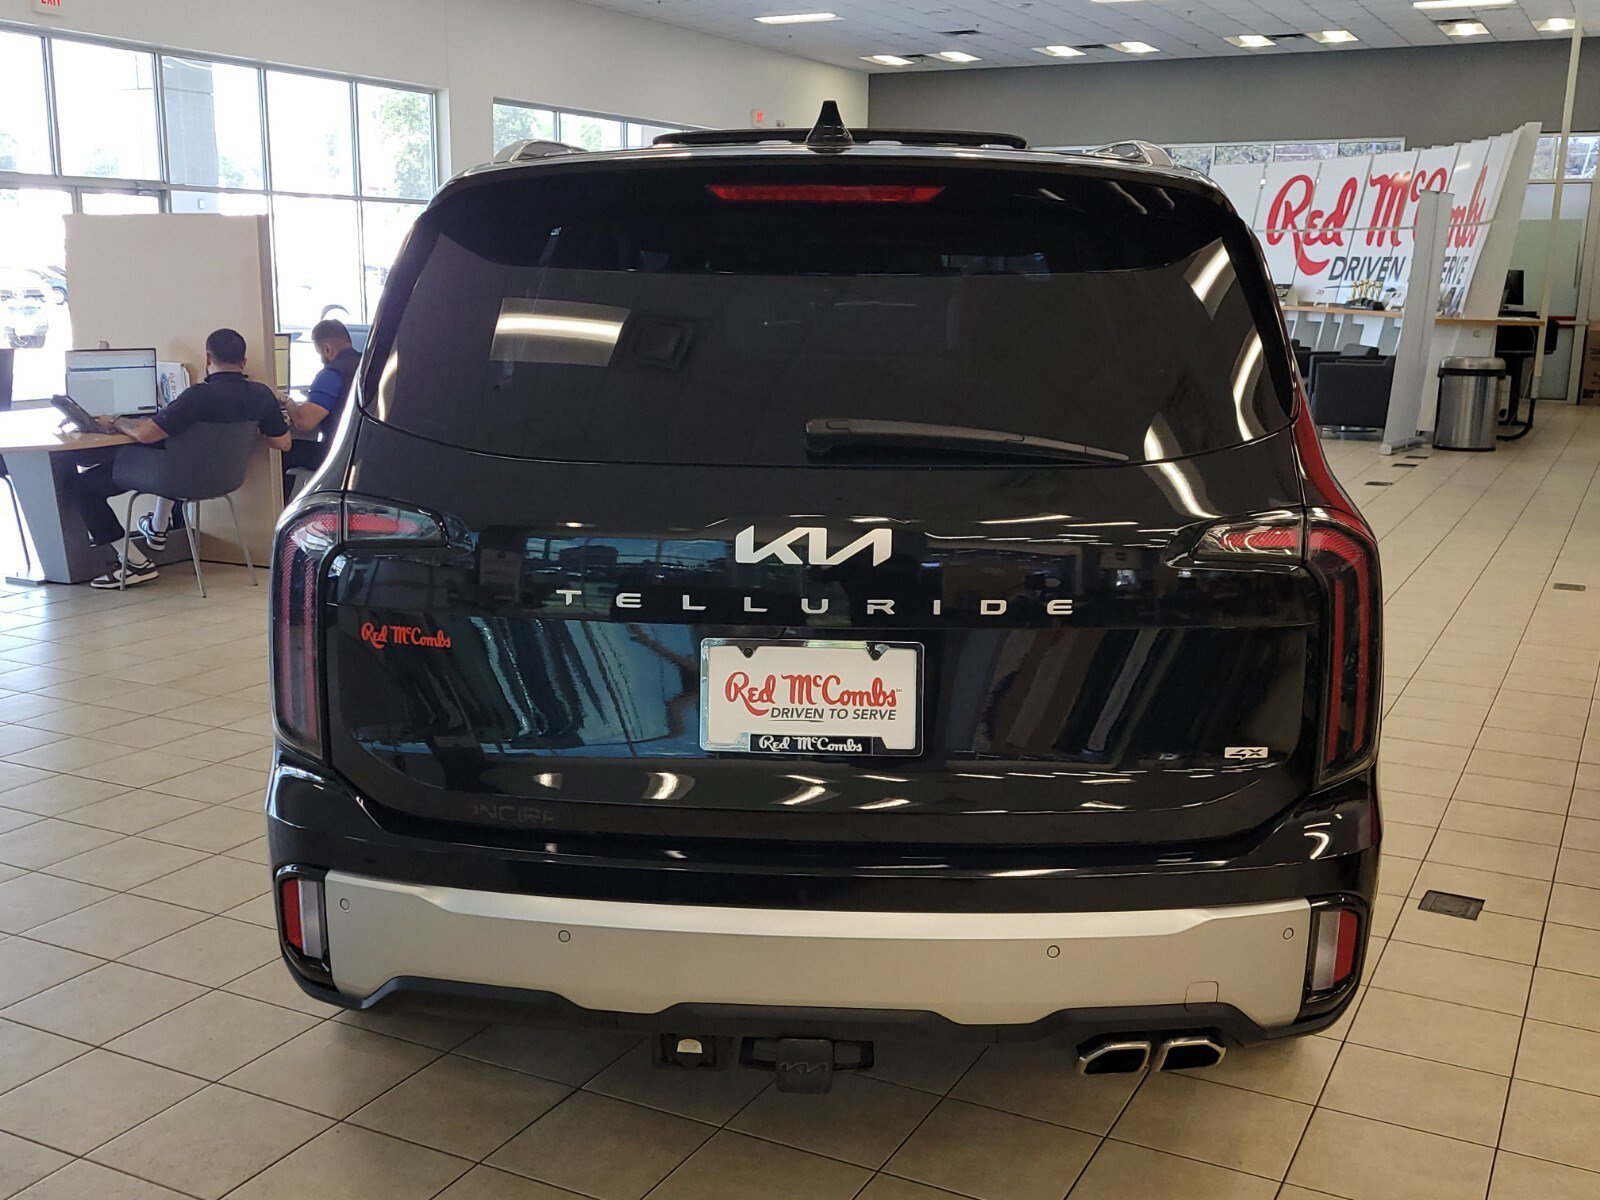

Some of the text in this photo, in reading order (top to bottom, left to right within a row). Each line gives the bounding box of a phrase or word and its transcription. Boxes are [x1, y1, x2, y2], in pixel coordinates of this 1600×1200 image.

[1266, 174, 1358, 276] Red
[1328, 256, 1469, 284] DRIVEN ERVE
[735, 525, 893, 567] KIA
[556, 589, 1075, 616] TELLURIDE
[361, 622, 452, 649] Red McCombs
[725, 671, 897, 716] Red McCombs
[770, 707, 896, 721] DRIVEN TO SERVE
[758, 735, 863, 752] Red McCombs
